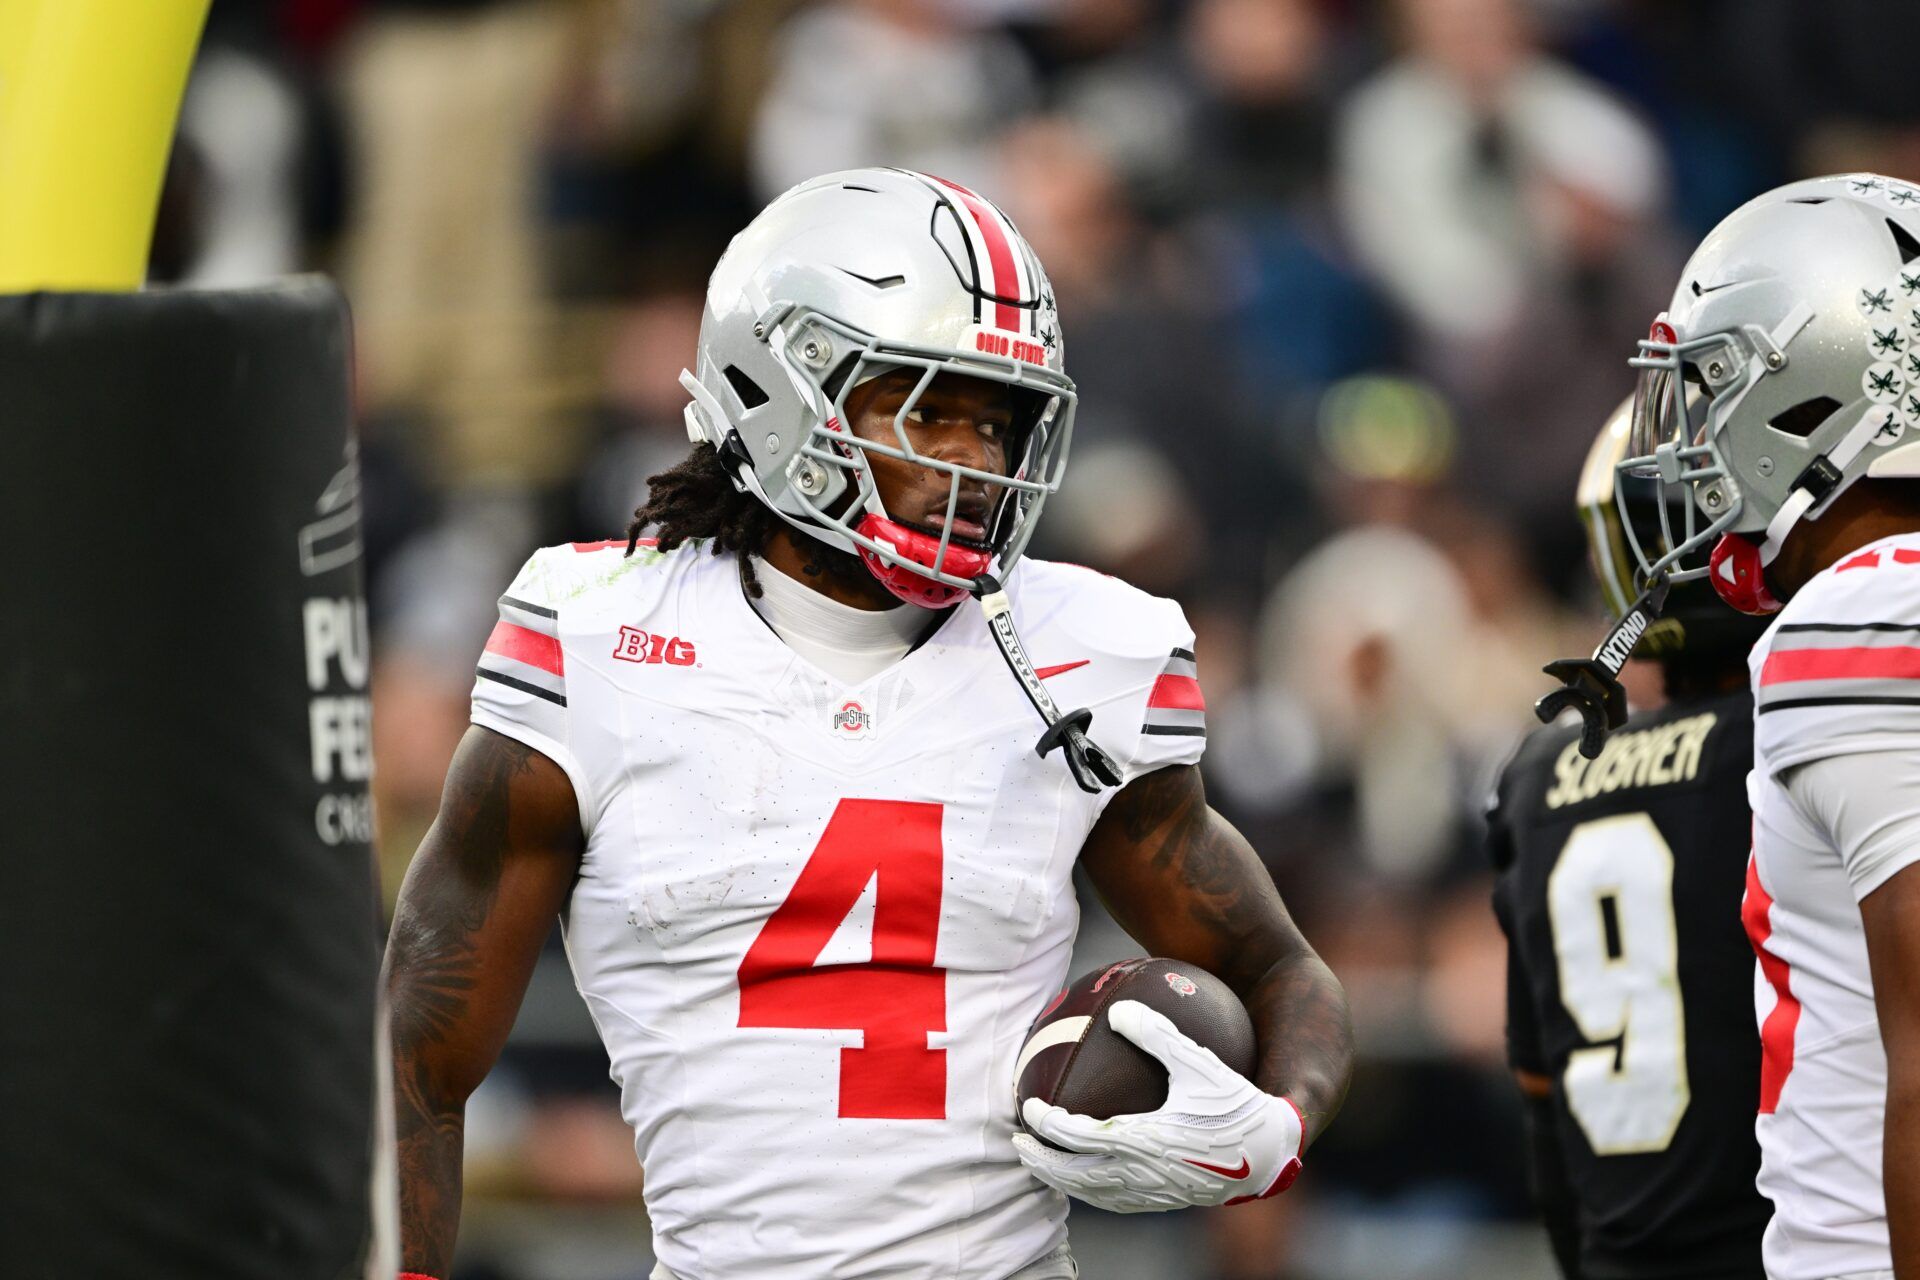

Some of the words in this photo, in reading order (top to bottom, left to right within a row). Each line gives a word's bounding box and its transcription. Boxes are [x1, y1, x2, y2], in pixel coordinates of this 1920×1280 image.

[976, 332, 1009, 356] OHIO
[1012, 340, 1045, 366] STATE
[995, 615, 1048, 704] BATTLE
[1599, 610, 1648, 674] NXTRND
[1546, 712, 1718, 810] SLUSHER
[737, 798, 948, 1120] 4
[1547, 811, 1691, 1157] 9
